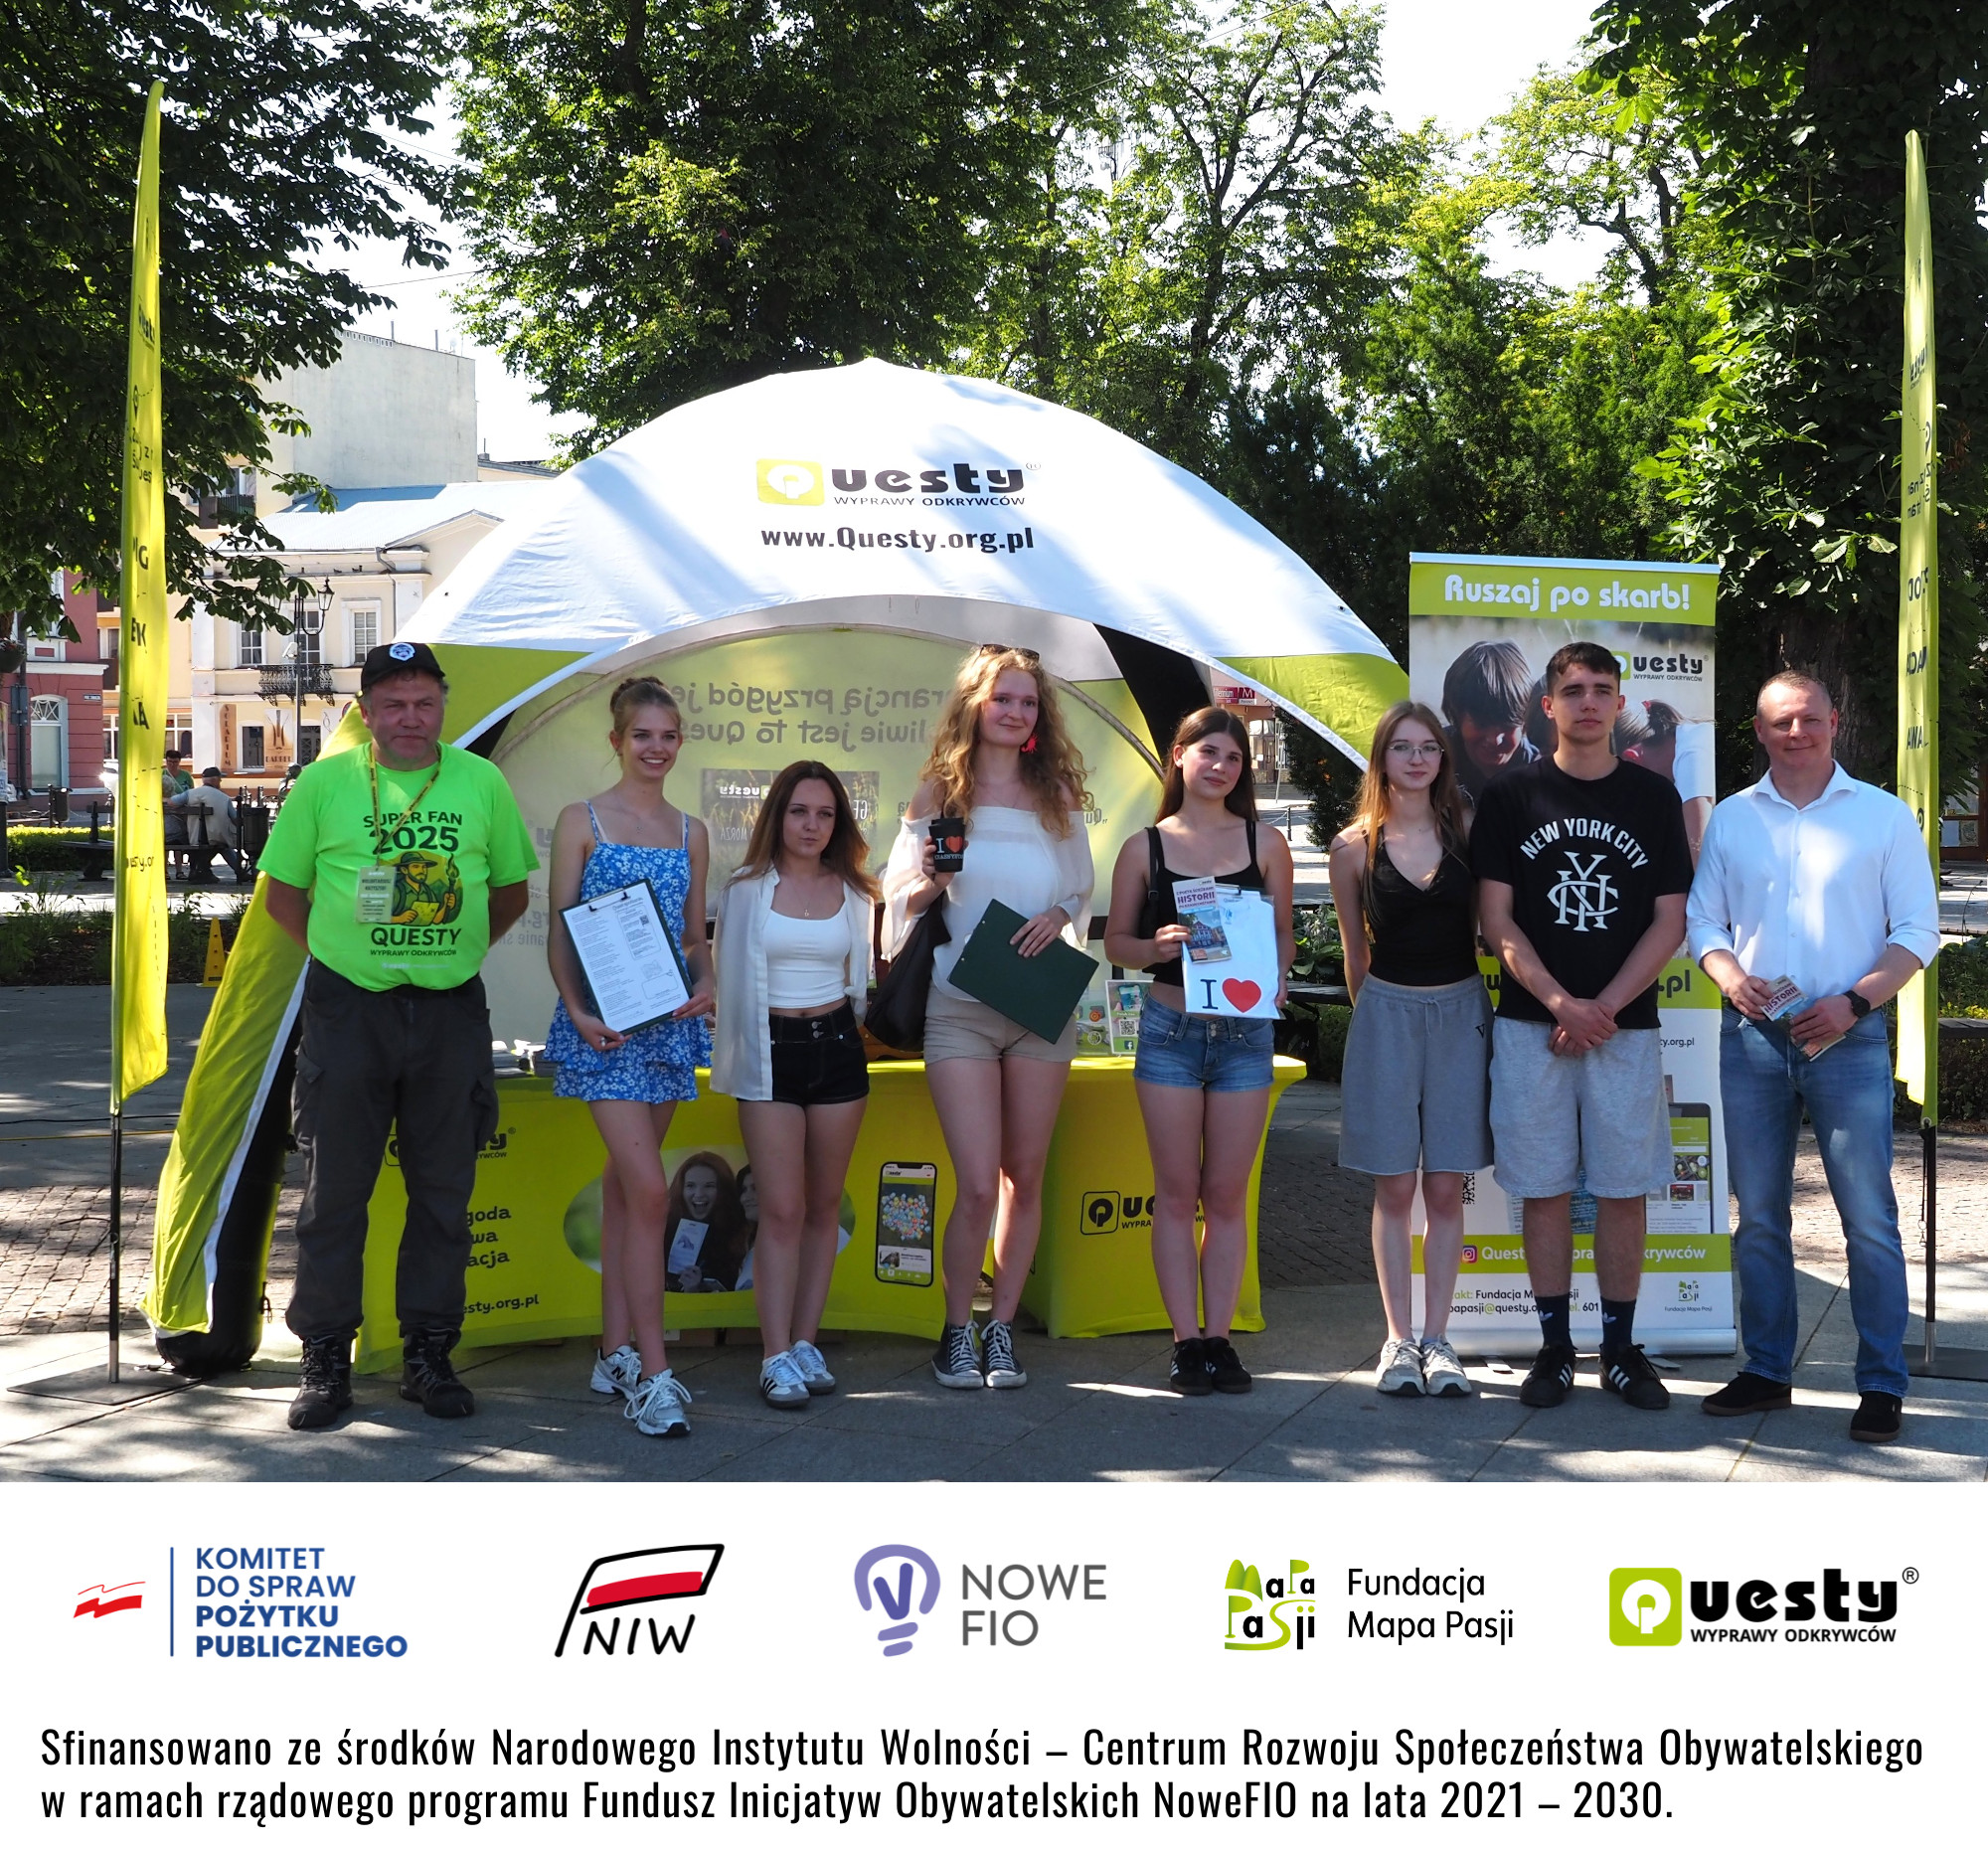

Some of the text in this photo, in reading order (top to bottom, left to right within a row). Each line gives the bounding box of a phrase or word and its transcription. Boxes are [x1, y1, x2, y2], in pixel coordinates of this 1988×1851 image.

[833, 494, 1026, 507] WYPRAWY ODKRYWCÓW
[760, 527, 1035, 554] www.Questy.org.pl
[1444, 574, 1691, 613] Ruszaj po skarb!
[1632, 672, 1704, 683] WYPRAWY ODKRYWCÓW
[428, 810, 463, 826] FAN
[369, 825, 459, 855] 2025
[1520, 817, 1649, 870] NEW YORK CITY
[1177, 891, 1216, 905] HISTORII
[371, 927, 462, 947] QUESTY
[370, 948, 411, 957] WYPRAWY
[1763, 986, 1798, 1014] HISTORII
[477, 1151, 508, 1160] YWCÓW
[466, 1206, 512, 1228] goda
[1121, 1220, 1152, 1230] WYPRA
[467, 1250, 511, 1268] acja
[1481, 1246, 1526, 1262] Quest
[1475, 1289, 1522, 1302] Fundacja
[1582, 1302, 1599, 1312] 601
